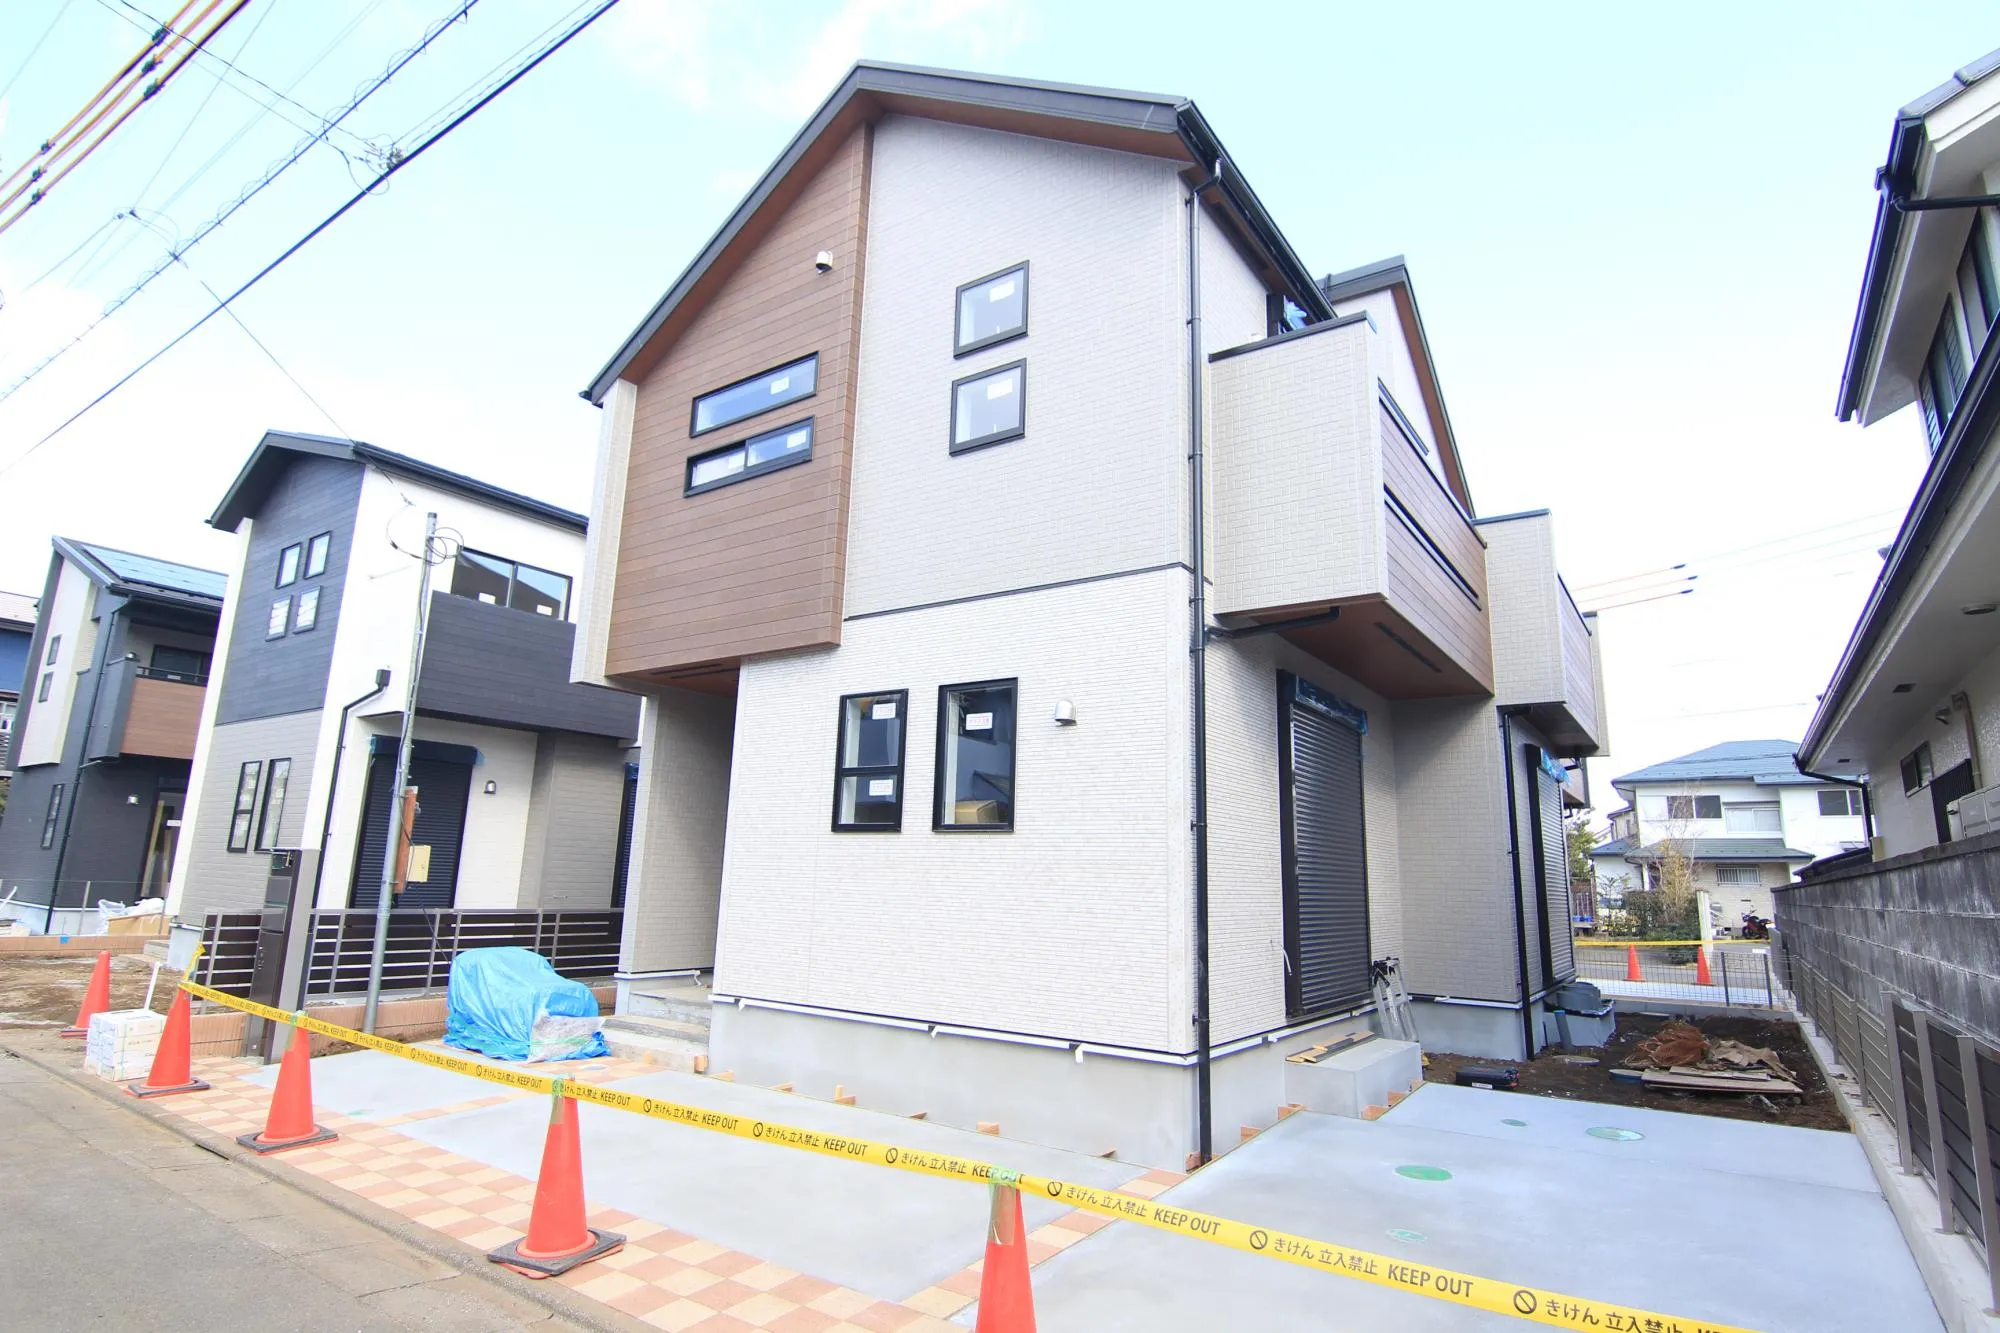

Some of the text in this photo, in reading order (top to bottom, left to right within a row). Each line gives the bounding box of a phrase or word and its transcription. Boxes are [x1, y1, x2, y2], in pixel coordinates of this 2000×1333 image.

[517, 1076, 542, 1088] KEEP OUT
[600, 1091, 631, 1106] KEEP OUT
[702, 1113, 739, 1131] KEEP OUT
[824, 1138, 868, 1156] KEEP OUT
[1154, 1207, 1221, 1236] KEEP OUT
[1388, 1263, 1473, 1298] KEEP OUT
